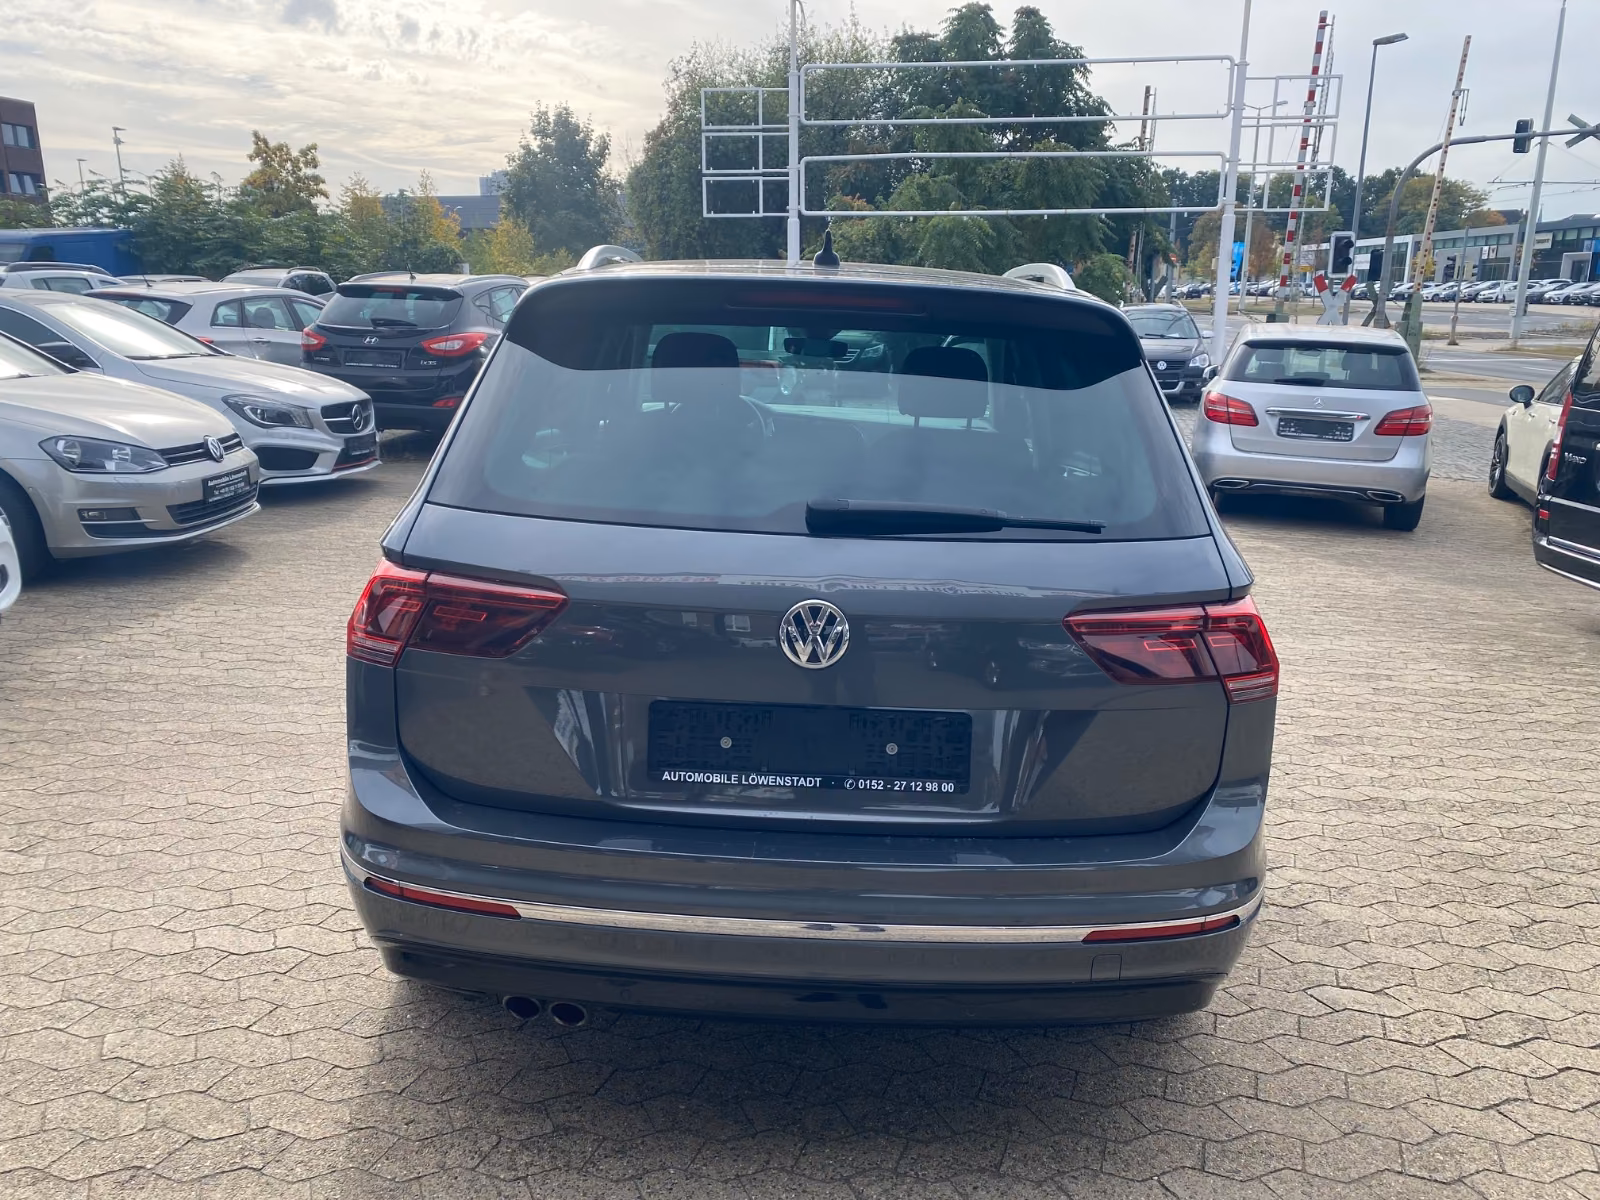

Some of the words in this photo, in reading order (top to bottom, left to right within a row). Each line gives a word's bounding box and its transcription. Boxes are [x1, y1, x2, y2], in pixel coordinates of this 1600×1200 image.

[662, 771, 738, 784] AUTOMOBILE
[742, 773, 822, 787] LÖWENSTADT
[858, 779, 884, 790] 0152
[893, 780, 907, 790] 27
[910, 781, 923, 791] 12
[925, 782, 939, 792] 98
[941, 782, 955, 793] 00
